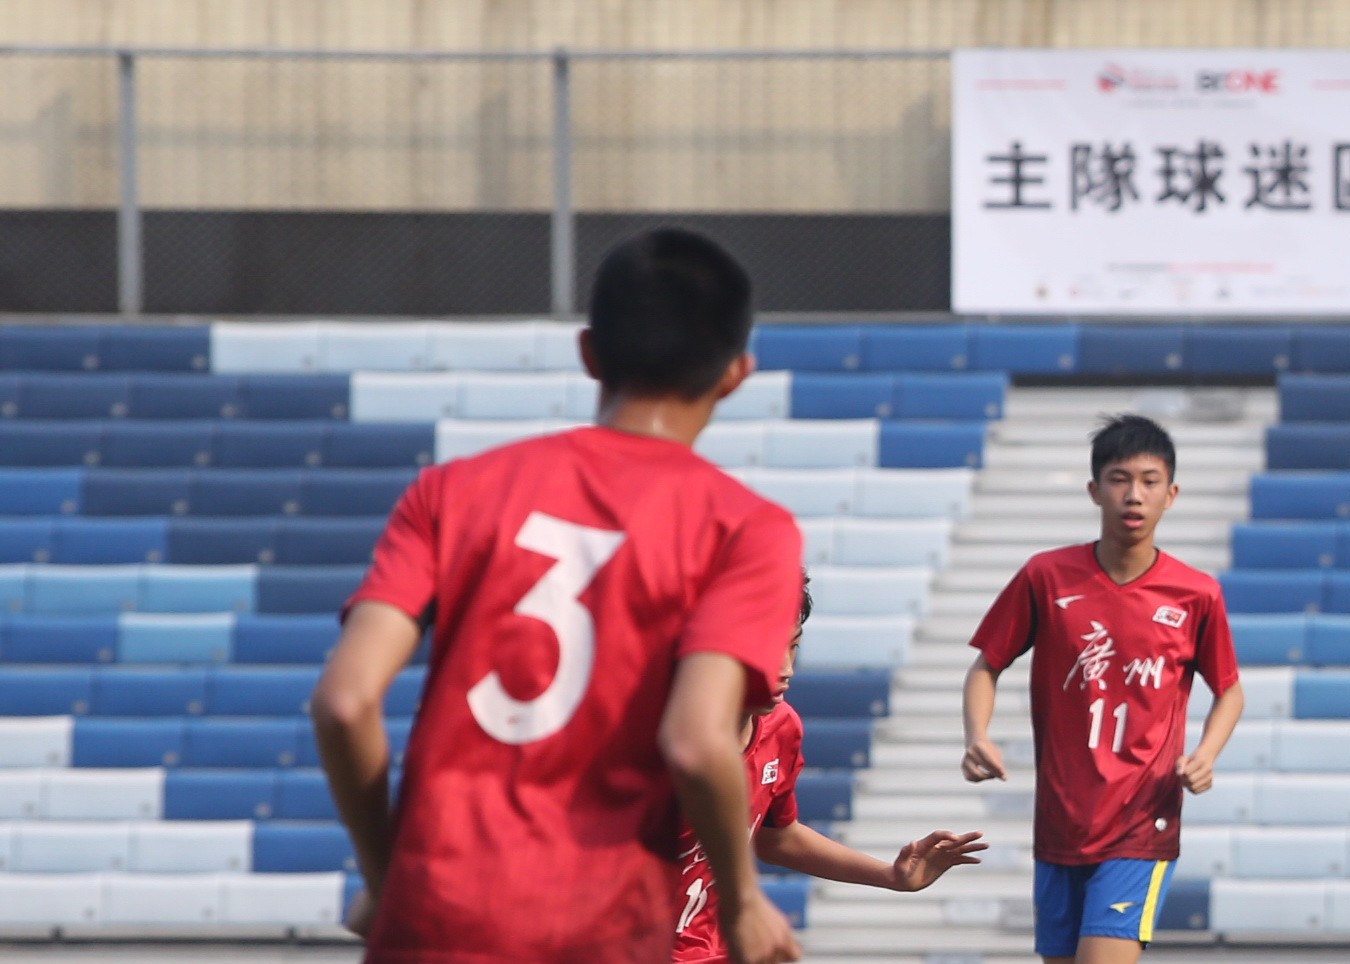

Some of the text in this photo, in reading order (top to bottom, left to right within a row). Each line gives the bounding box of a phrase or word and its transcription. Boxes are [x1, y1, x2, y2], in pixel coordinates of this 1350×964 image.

[466, 510, 628, 746] 3
[1063, 620, 1165, 691] 廣州
[1088, 698, 1128, 753] 11
